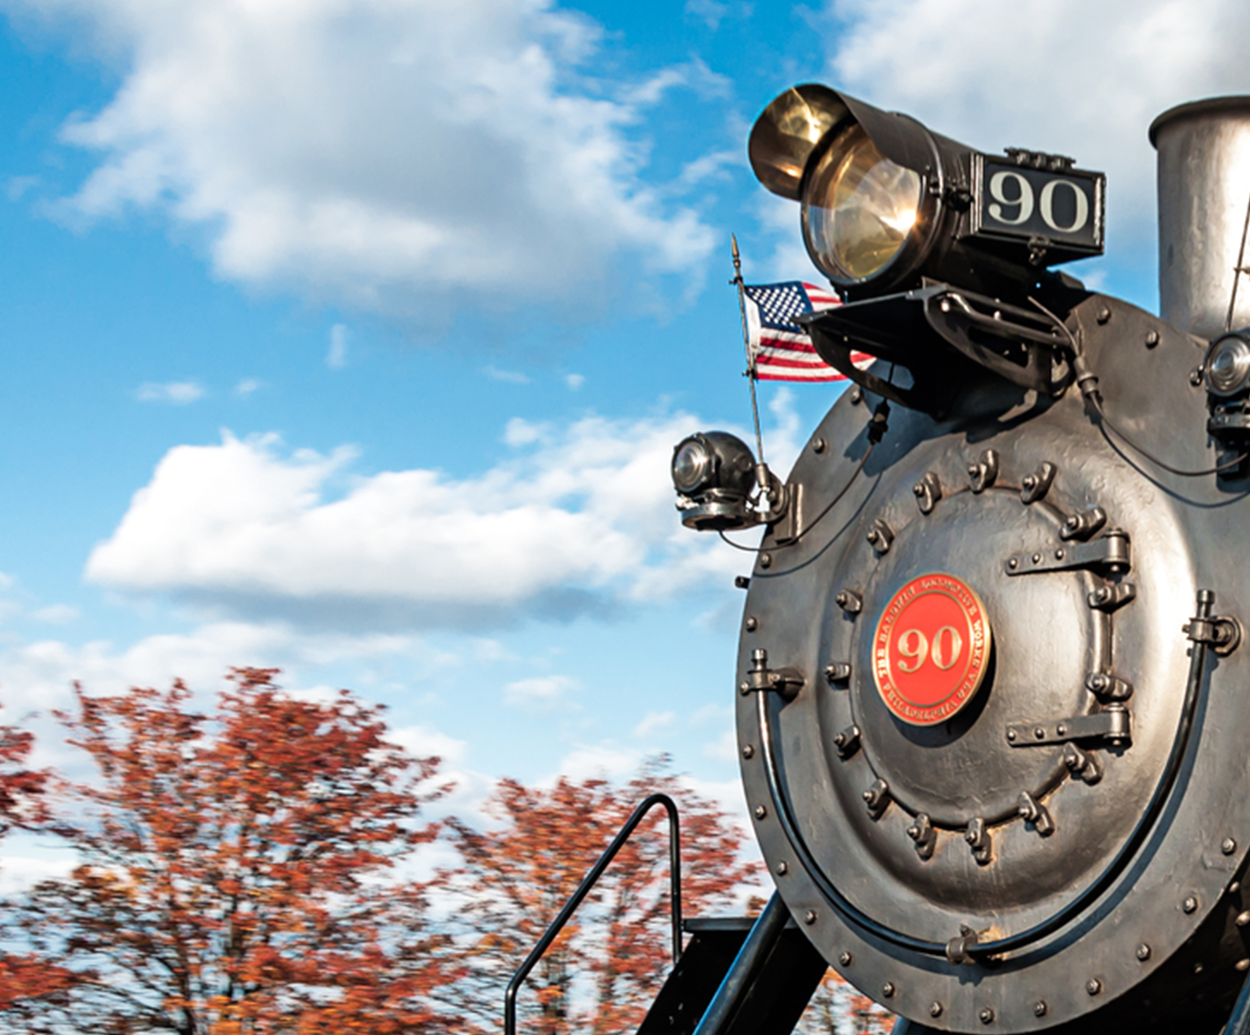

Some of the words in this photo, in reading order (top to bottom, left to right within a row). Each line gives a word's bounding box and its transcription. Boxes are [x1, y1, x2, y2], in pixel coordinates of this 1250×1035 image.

[988, 171, 1088, 233] 90
[879, 586, 915, 644] BALDWIN
[920, 578, 978, 616] LOCOMOTIVE
[972, 619, 983, 668] WORKS
[897, 625, 963, 673] 90
[882, 682, 957, 721] PHILADELPHIA
